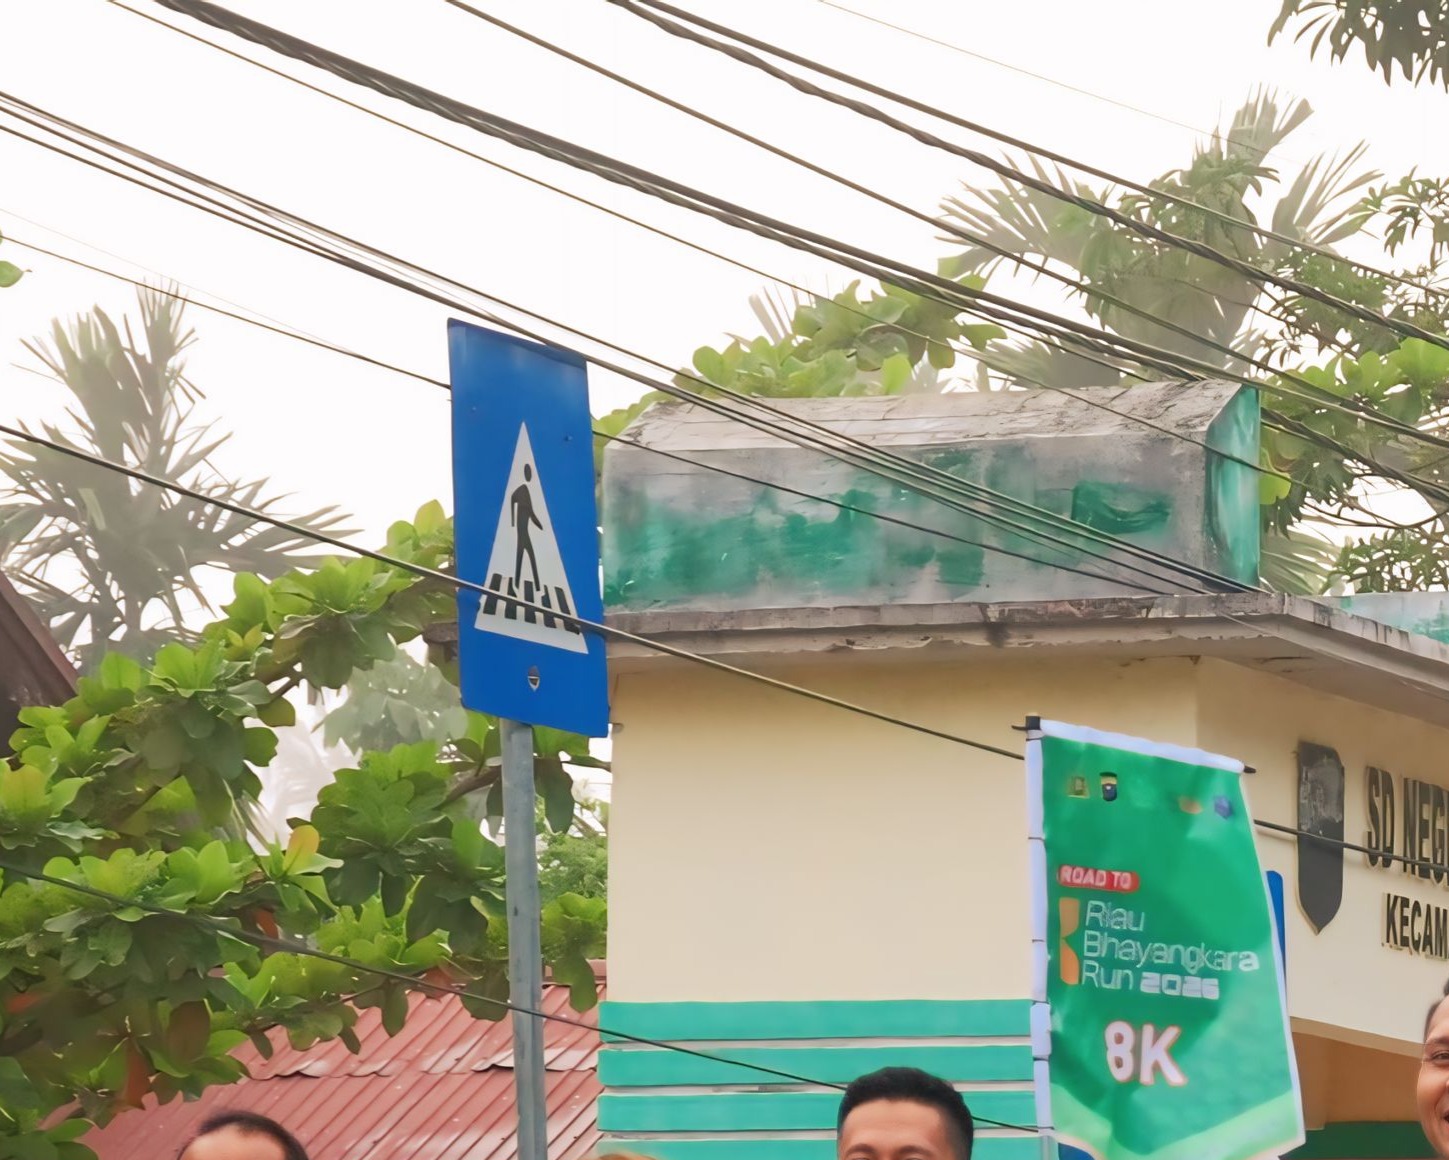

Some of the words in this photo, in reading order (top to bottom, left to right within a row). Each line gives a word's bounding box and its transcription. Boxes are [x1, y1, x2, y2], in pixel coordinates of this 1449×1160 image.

[1364, 766, 1395, 868] SD
[1059, 865, 1107, 887] ROAD
[1112, 871, 1132, 890] TO
[1085, 899, 1145, 932] Riau
[1083, 929, 1260, 975] Bhayangkara
[1081, 959, 1134, 991] Run
[1104, 1021, 1188, 1087] 8K
